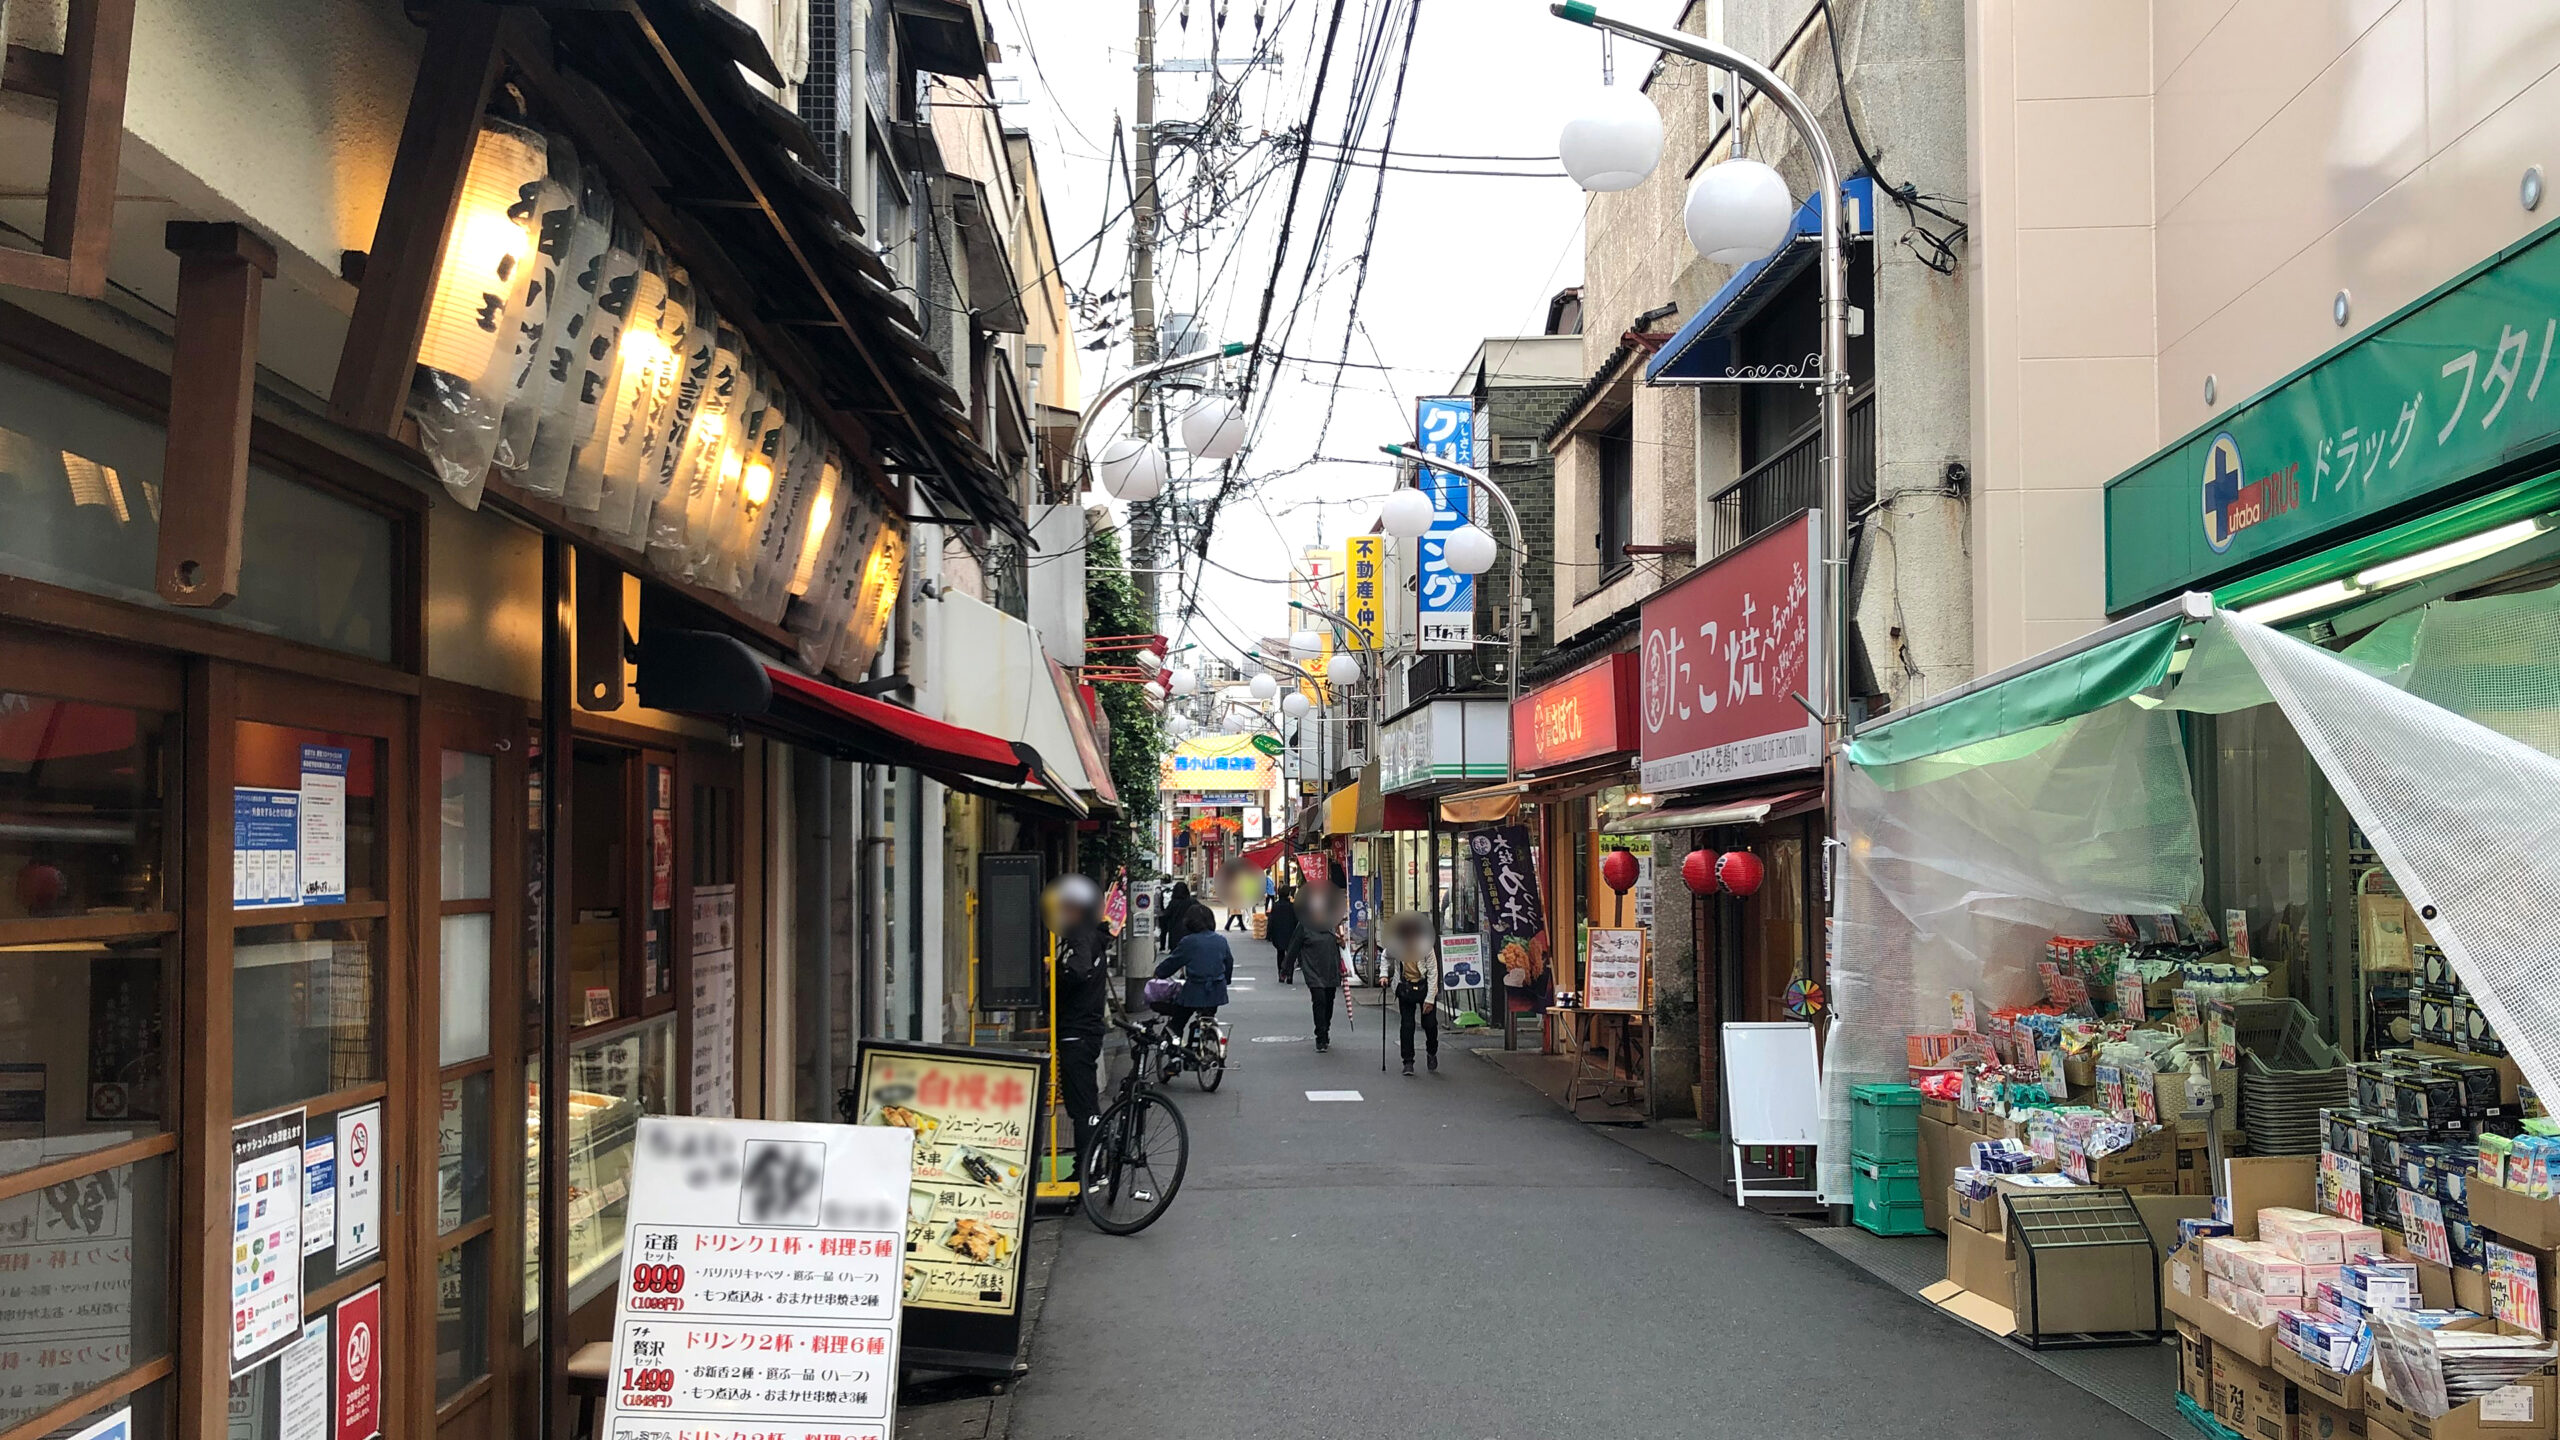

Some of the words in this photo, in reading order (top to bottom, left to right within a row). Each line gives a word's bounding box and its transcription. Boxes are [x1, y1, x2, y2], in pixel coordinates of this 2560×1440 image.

[2312, 391, 2423, 502] ドラッグ
[1423, 407, 1463, 608] クリーニング
[2229, 503, 2260, 533] utaba
[2263, 462, 2299, 521] DRUG
[2336, 1187, 2362, 1221] 698
[644, 1234, 678, 1251] 定番
[695, 1233, 893, 1258] ドリンク1杯・料理5種
[644, 1252, 675, 1262] セット
[633, 1263, 685, 1294] 999
[350, 1332, 367, 1365] 20
[633, 1340, 665, 1357] 贅沢
[687, 1331, 885, 1356] ドリンク2杯・料理6種
[634, 1357, 662, 1367] セット
[622, 1367, 675, 1392] 1499
